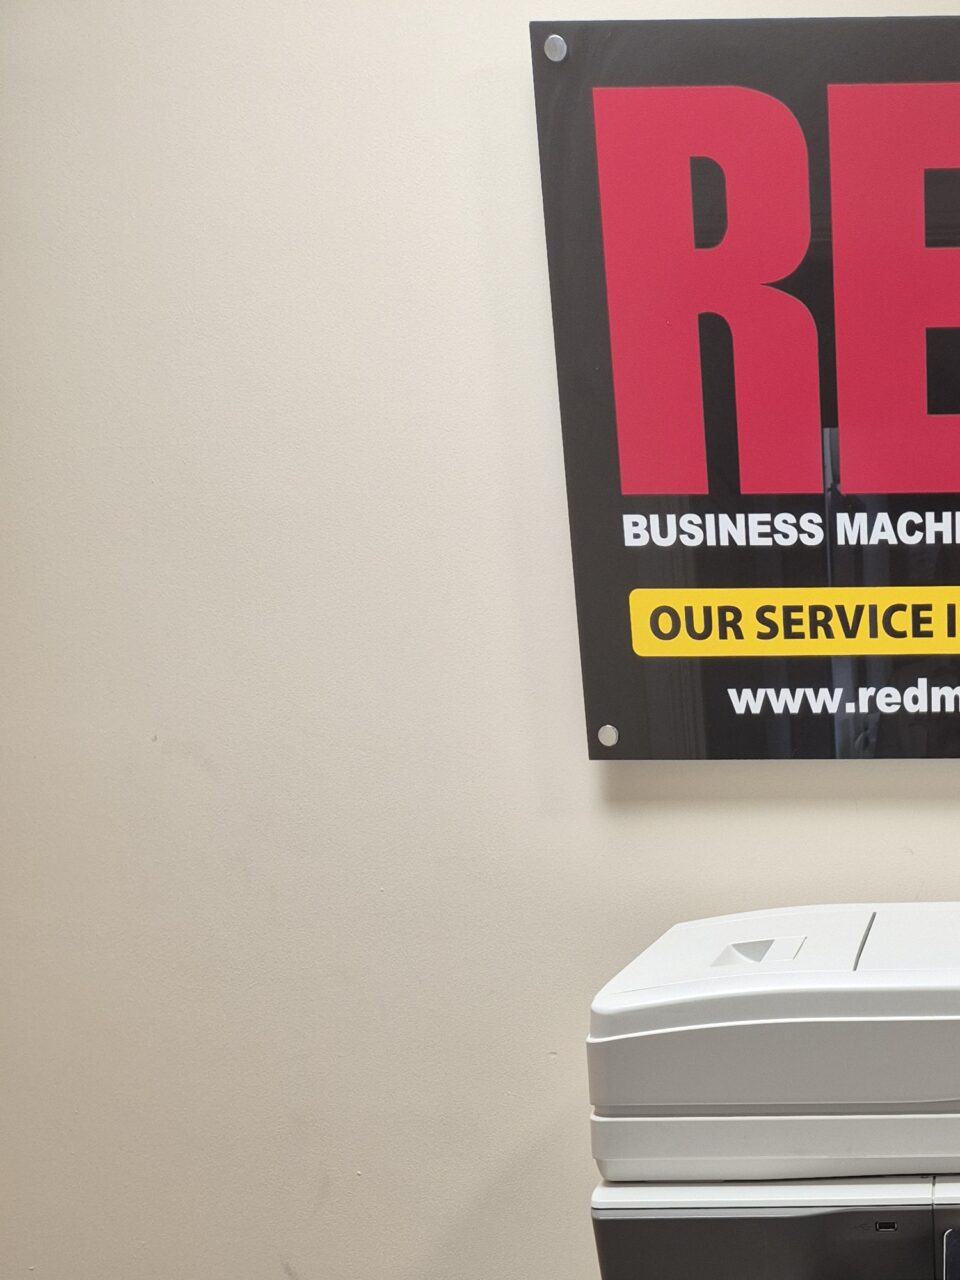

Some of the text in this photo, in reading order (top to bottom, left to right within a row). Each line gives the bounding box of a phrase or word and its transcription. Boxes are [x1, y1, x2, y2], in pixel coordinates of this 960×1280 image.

[622, 512, 824, 547] BUSINESS
[650, 605, 744, 640] OUR
[755, 603, 934, 640] SERVICE
